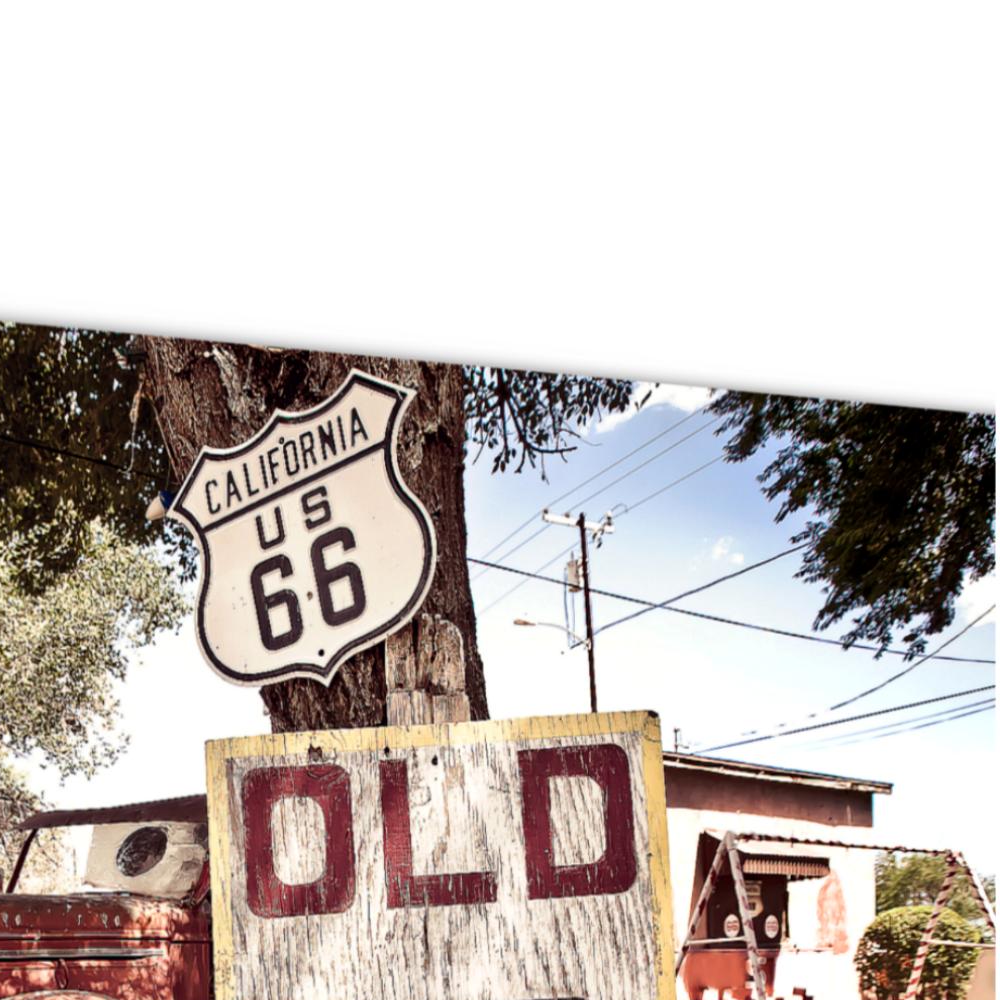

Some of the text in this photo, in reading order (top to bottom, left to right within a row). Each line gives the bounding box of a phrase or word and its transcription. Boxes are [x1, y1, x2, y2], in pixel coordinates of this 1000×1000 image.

[204, 407, 370, 515] CALIFORNIA
[250, 526, 366, 652] 66
[241, 742, 638, 919] OLD
